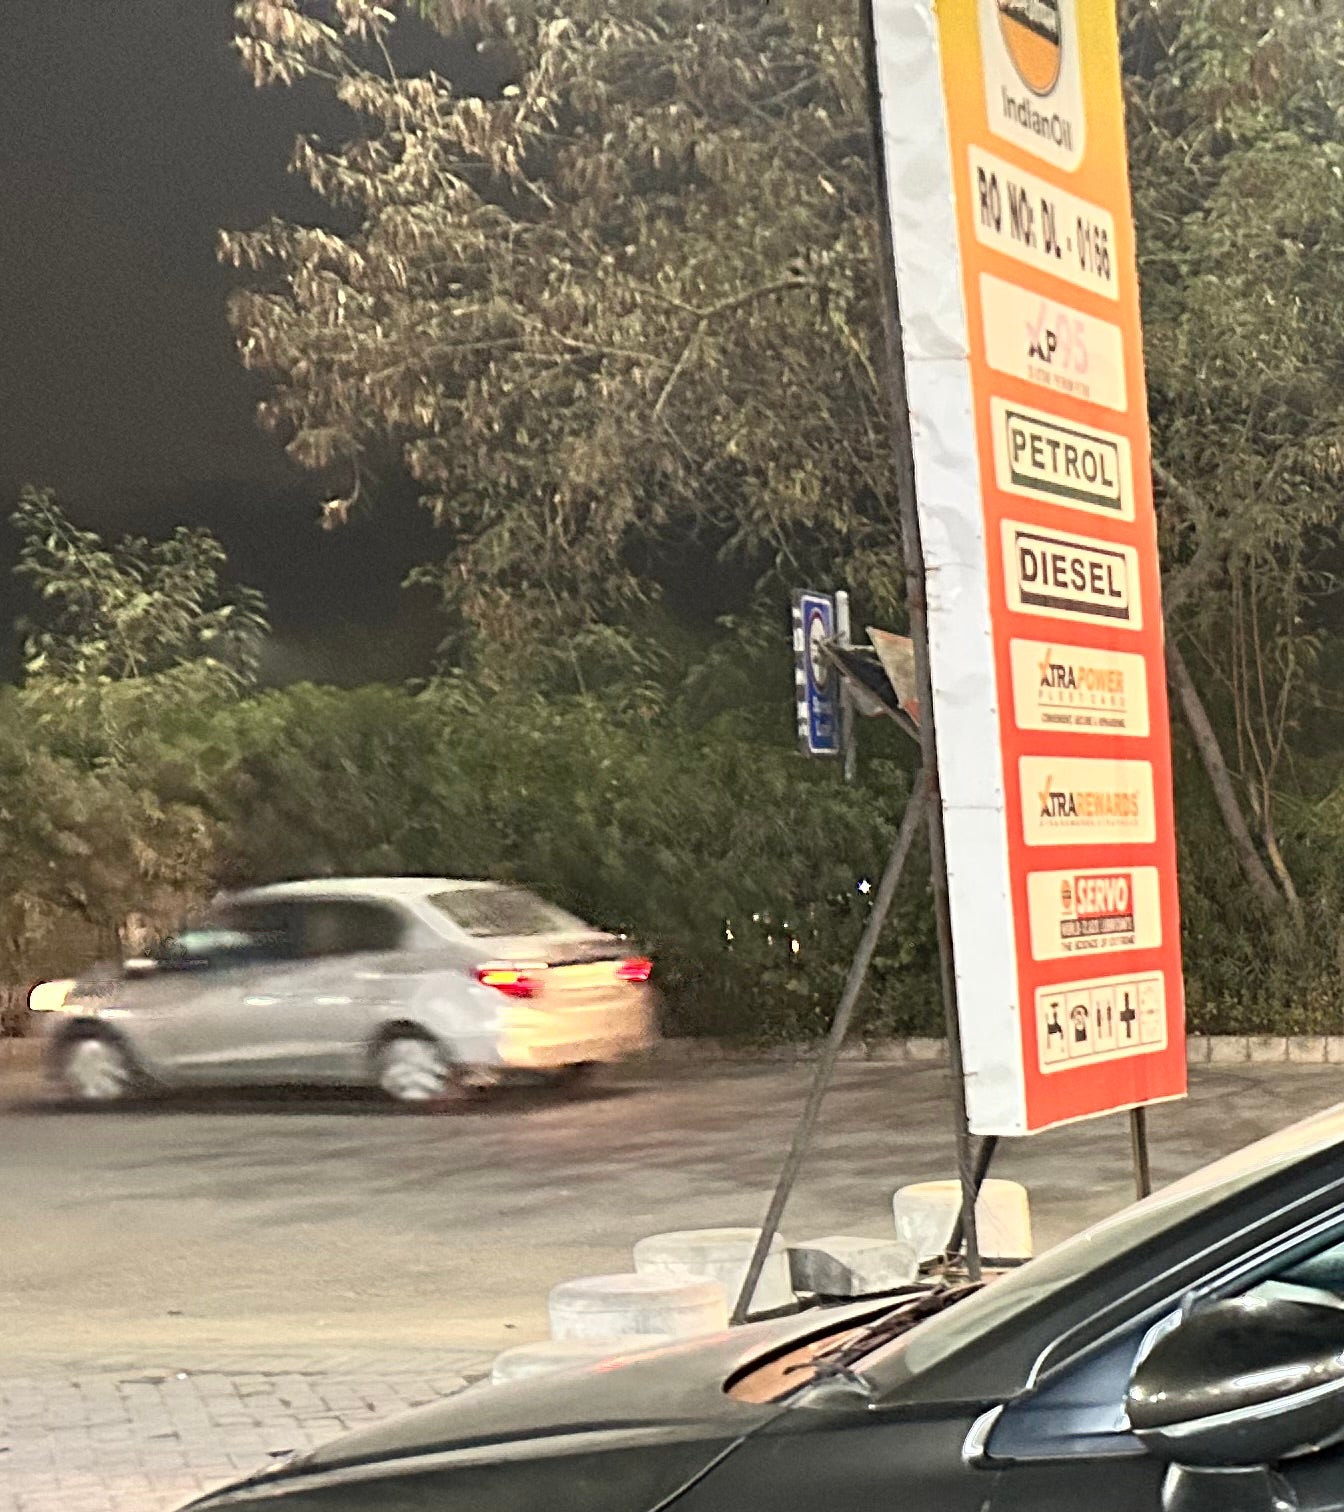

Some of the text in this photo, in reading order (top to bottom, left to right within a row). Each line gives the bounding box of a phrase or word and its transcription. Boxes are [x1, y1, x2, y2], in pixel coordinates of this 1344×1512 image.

[1002, 84, 1073, 151] IndianOil
[977, 166, 1001, 233] RO
[1041, 197, 1061, 259] DL
[1012, 428, 1114, 488] PETROL
[1020, 547, 1122, 598] DIESEL
[1077, 877, 1129, 914] SERVO
